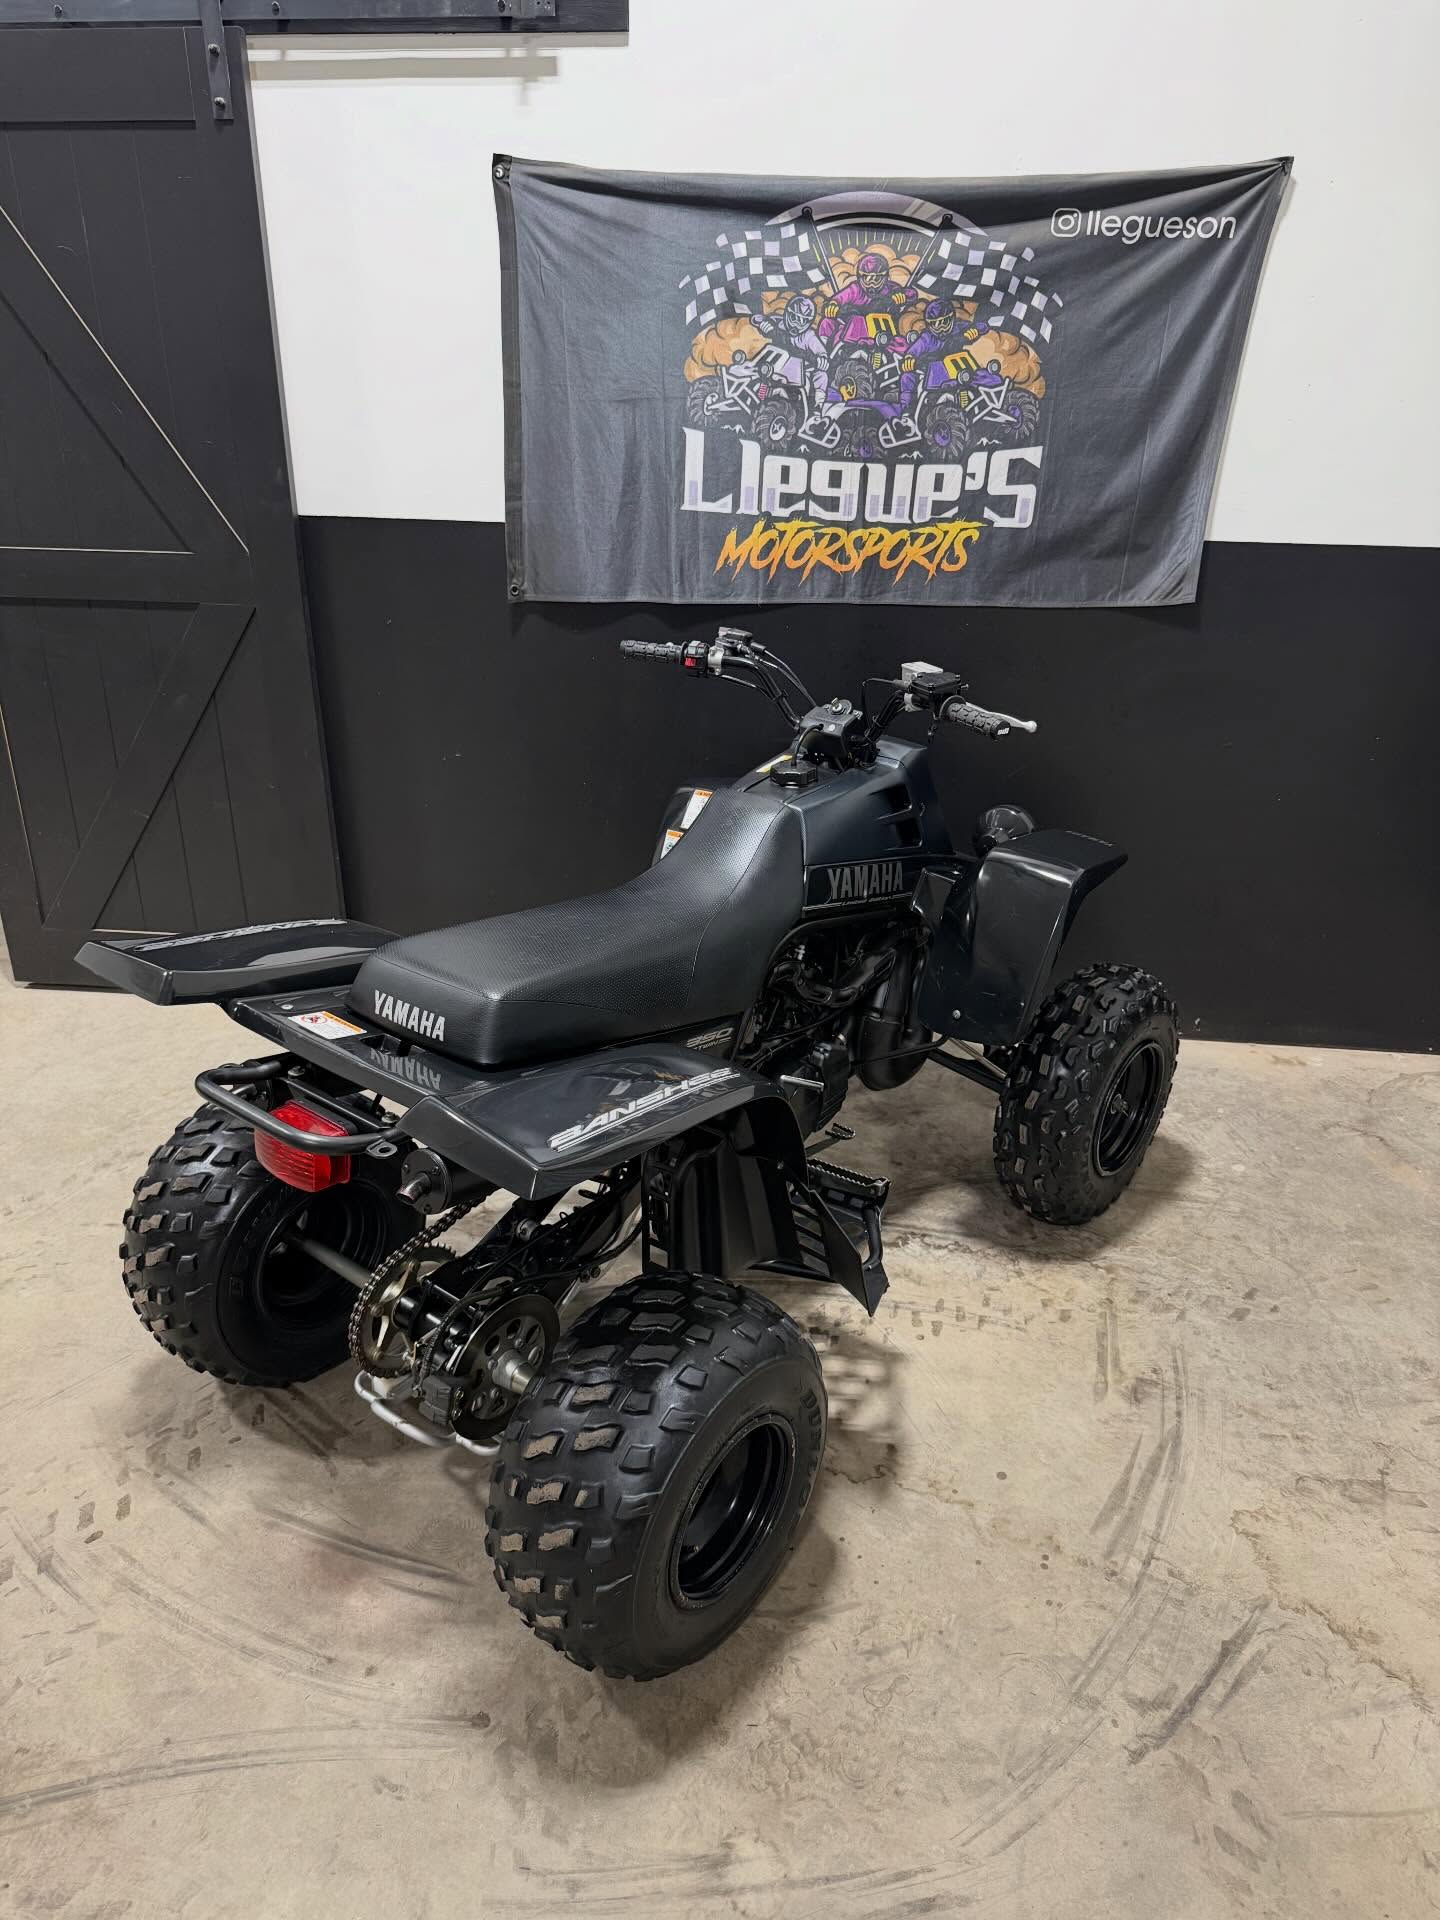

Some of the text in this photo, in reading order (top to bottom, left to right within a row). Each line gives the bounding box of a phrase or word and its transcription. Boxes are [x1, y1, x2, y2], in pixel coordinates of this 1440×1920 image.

[1086, 210, 1237, 245] llegueson
[713, 516, 988, 587] MOTORSPORTS
[827, 861, 903, 900] YAMAHA
[374, 989, 446, 1042] YAMAHA
[549, 1066, 736, 1151] BANSHEE
